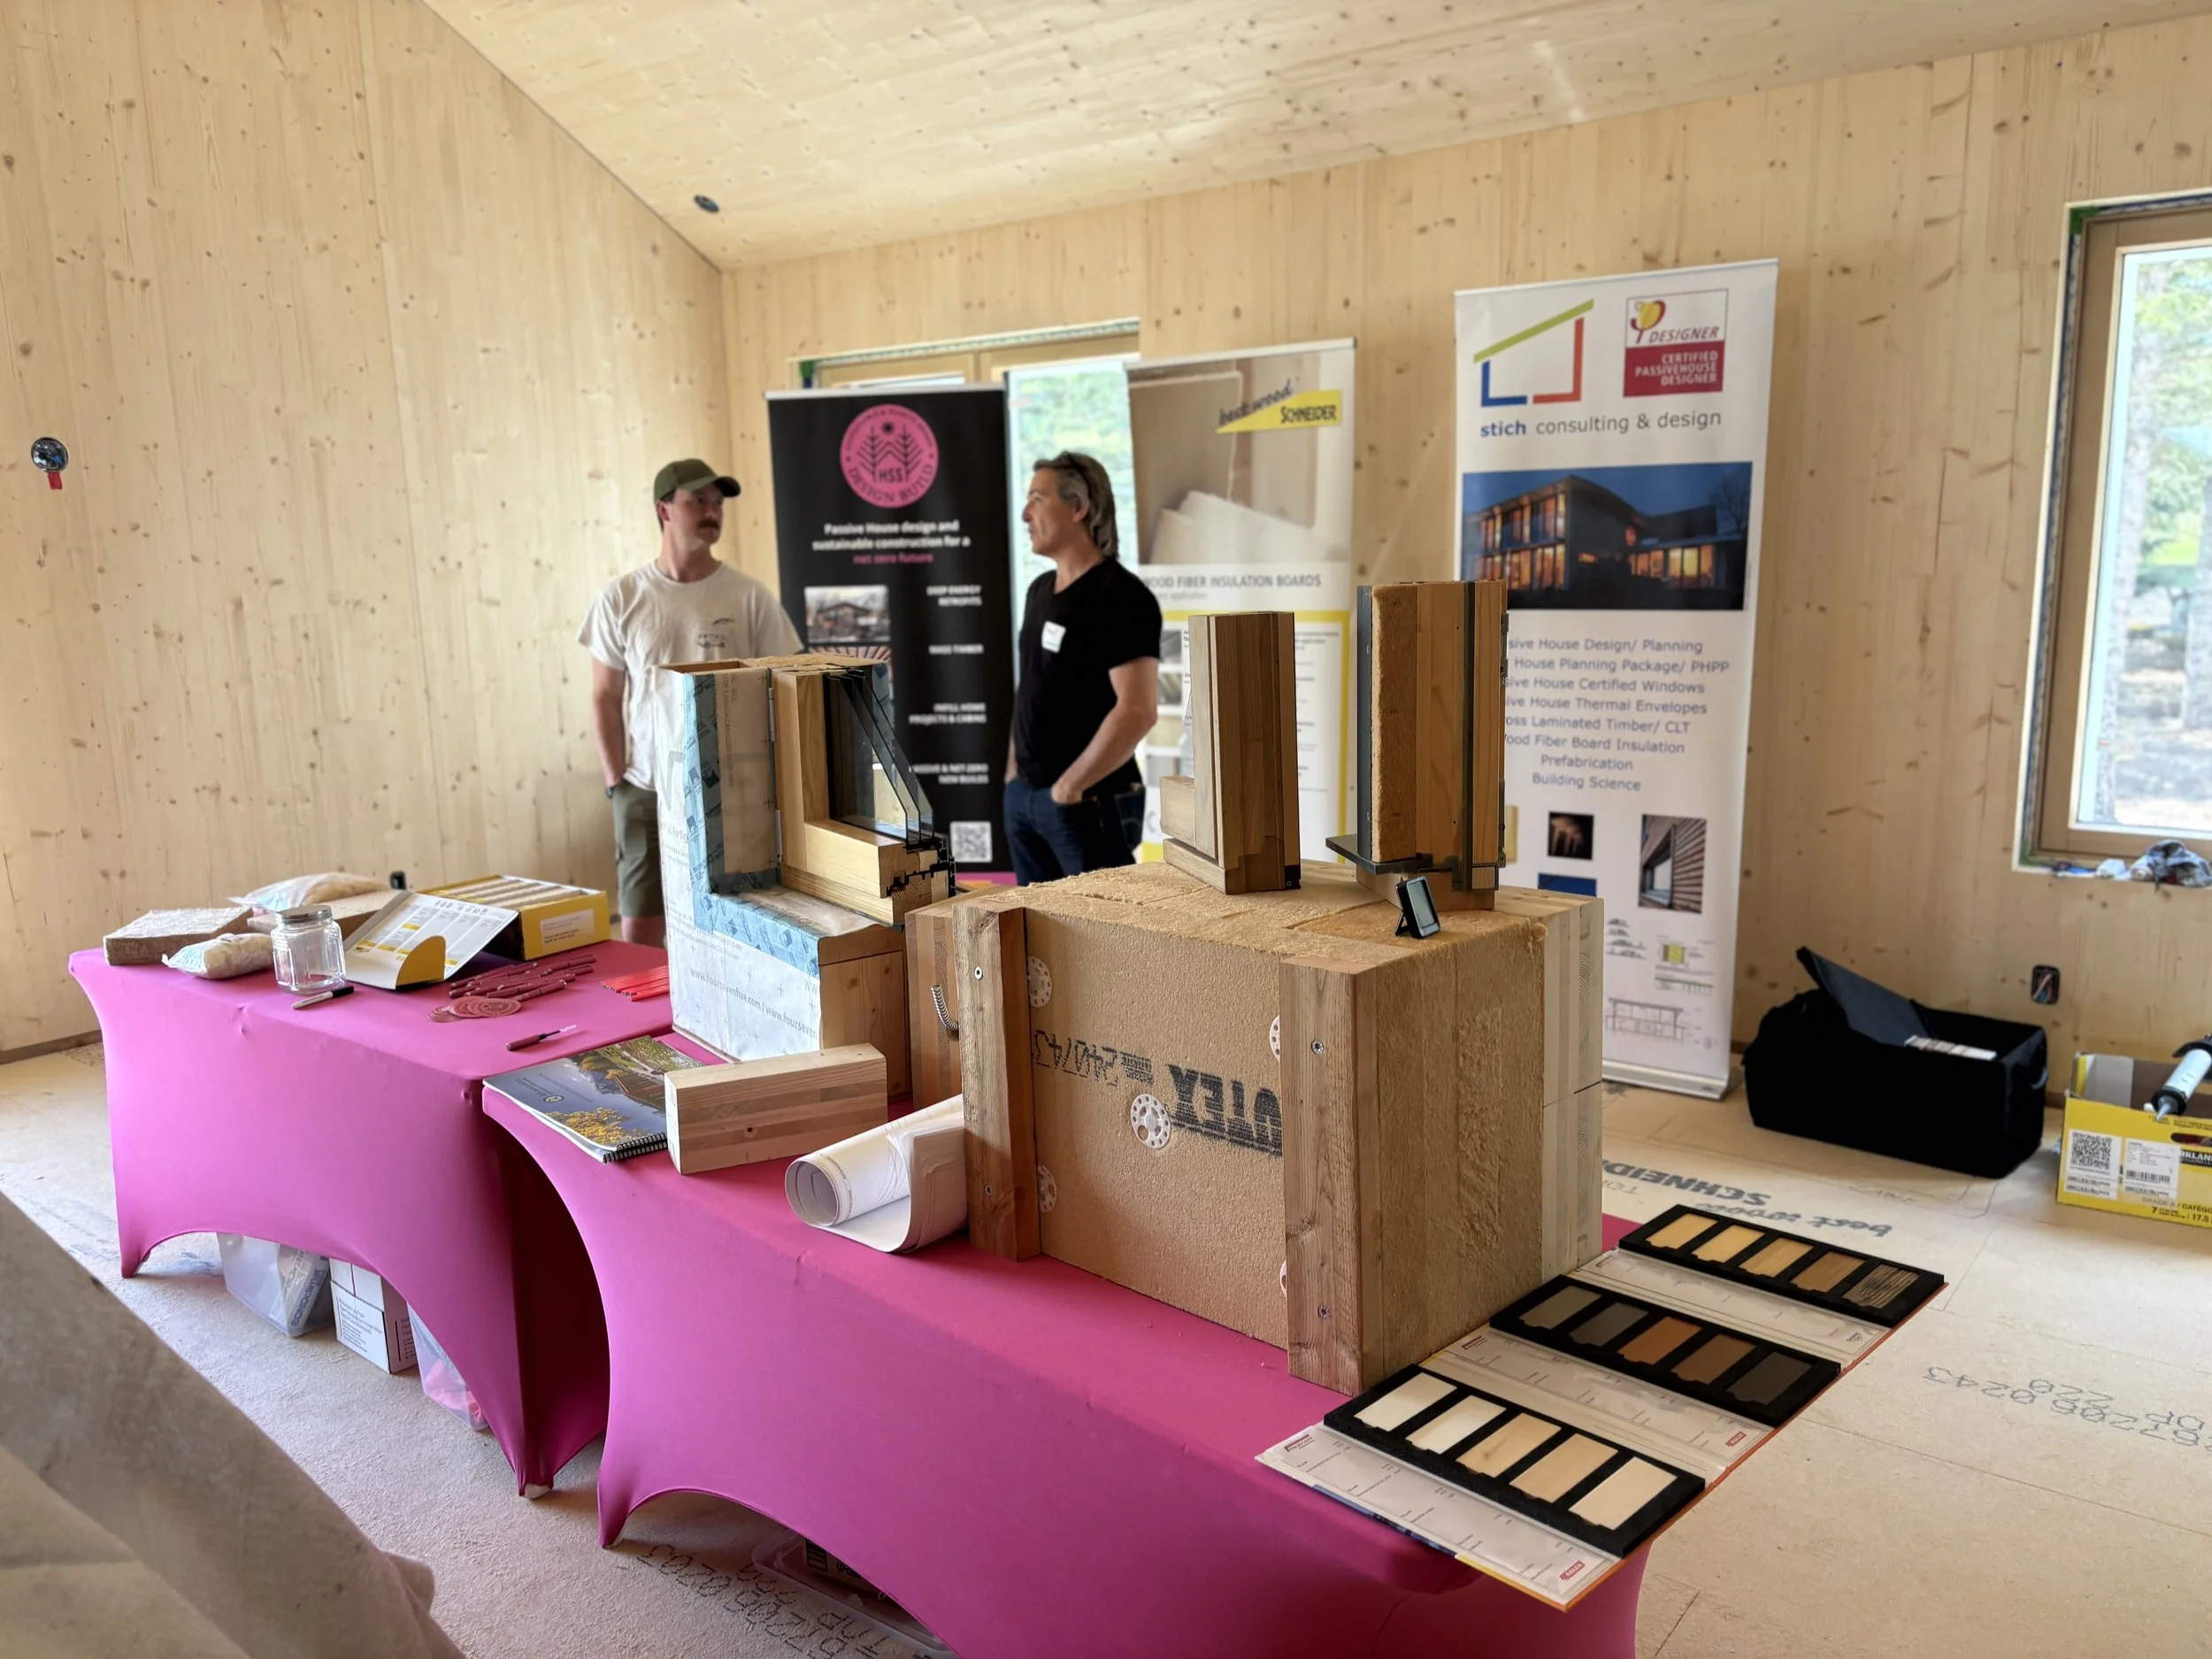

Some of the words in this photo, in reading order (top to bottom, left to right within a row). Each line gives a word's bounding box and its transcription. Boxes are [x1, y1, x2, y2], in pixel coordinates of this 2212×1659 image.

[1648, 326, 1719, 343] DESIGNER
[1662, 350, 1718, 365] CERTIFIED
[1635, 363, 1717, 378] PASSIVEHOUSE
[1661, 373, 1717, 387] DESIGNER
[1280, 404, 1337, 423] SCHNEIDER
[1480, 420, 1527, 438] stich
[1536, 416, 1629, 435] consulting
[1636, 412, 1650, 429] &
[1657, 411, 1722, 430] design
[1178, 576, 1206, 588] FIBER
[1210, 575, 1272, 588] INSULATION
[1277, 574, 1322, 588] BOARDS
[1538, 640, 1579, 650] House
[1584, 639, 1637, 654] Design/
[1642, 639, 1703, 655] Planning
[1515, 657, 1555, 670] House
[1559, 658, 1617, 672] Planning
[1622, 659, 1687, 675] Package/
[1691, 661, 1731, 673] PHPP
[1533, 678, 1574, 690] House
[1578, 679, 1637, 692] Certified
[1641, 680, 1705, 694] Windows
[1530, 696, 1571, 709] House
[1575, 697, 1631, 710] Thermal
[1636, 700, 1708, 715] Envelopes
[1532, 716, 1601, 730] Laminated
[1606, 718, 1660, 734] Timber/
[1665, 721, 1691, 734] CLT
[1504, 733, 1530, 746] ood
[1535, 734, 1566, 747] Fiber
[1571, 737, 1611, 750] Board
[1617, 739, 1685, 754] Insulation
[1541, 755, 1633, 771] Prefabrication
[1532, 772, 1585, 789] Building
[1589, 776, 1641, 791] Science
[1602, 1160, 1771, 1206] SCHNEID
[1807, 1216, 1893, 1237] best
